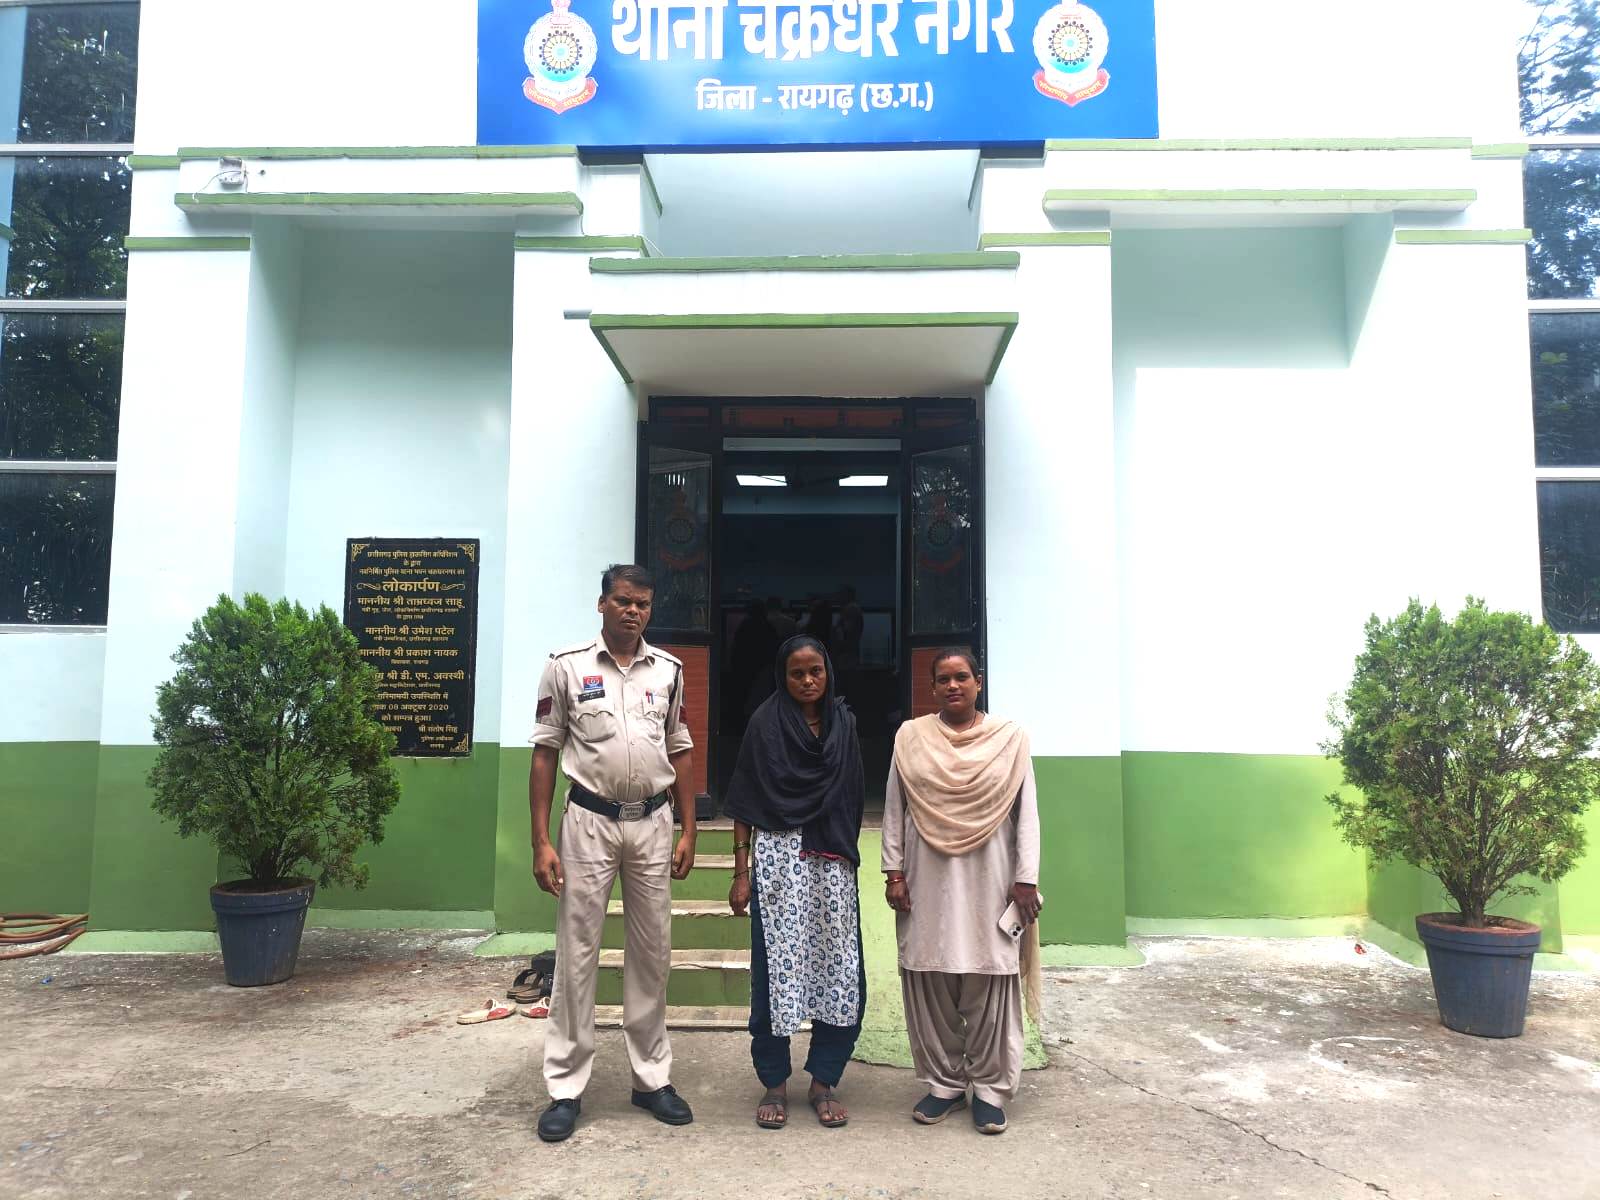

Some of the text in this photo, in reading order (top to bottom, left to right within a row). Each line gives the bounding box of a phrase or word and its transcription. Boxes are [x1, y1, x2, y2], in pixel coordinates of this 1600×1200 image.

[611, 0, 1015, 61] थाना चक्रधर नगर
[695, 78, 757, 111] जिला
[778, 83, 854, 115] रायगढ़
[860, 81, 934, 112] (छ.ग.)
[381, 577, 440, 592] लोकार्पण
[357, 595, 390, 605] माननीय
[392, 595, 403, 606] श्री
[445, 597, 465, 608] साहू
[365, 625, 455, 635] माननीय श्री उमेश पटेल
[393, 646, 403, 656] श्री
[405, 648, 431, 657] प्रकाश
[433, 648, 459, 657] नायक
[387, 670, 398, 680] श्री
[400, 670, 412, 680] डी.
[415, 672, 430, 681] एम.
[433, 670, 464, 680] अवस्थी
